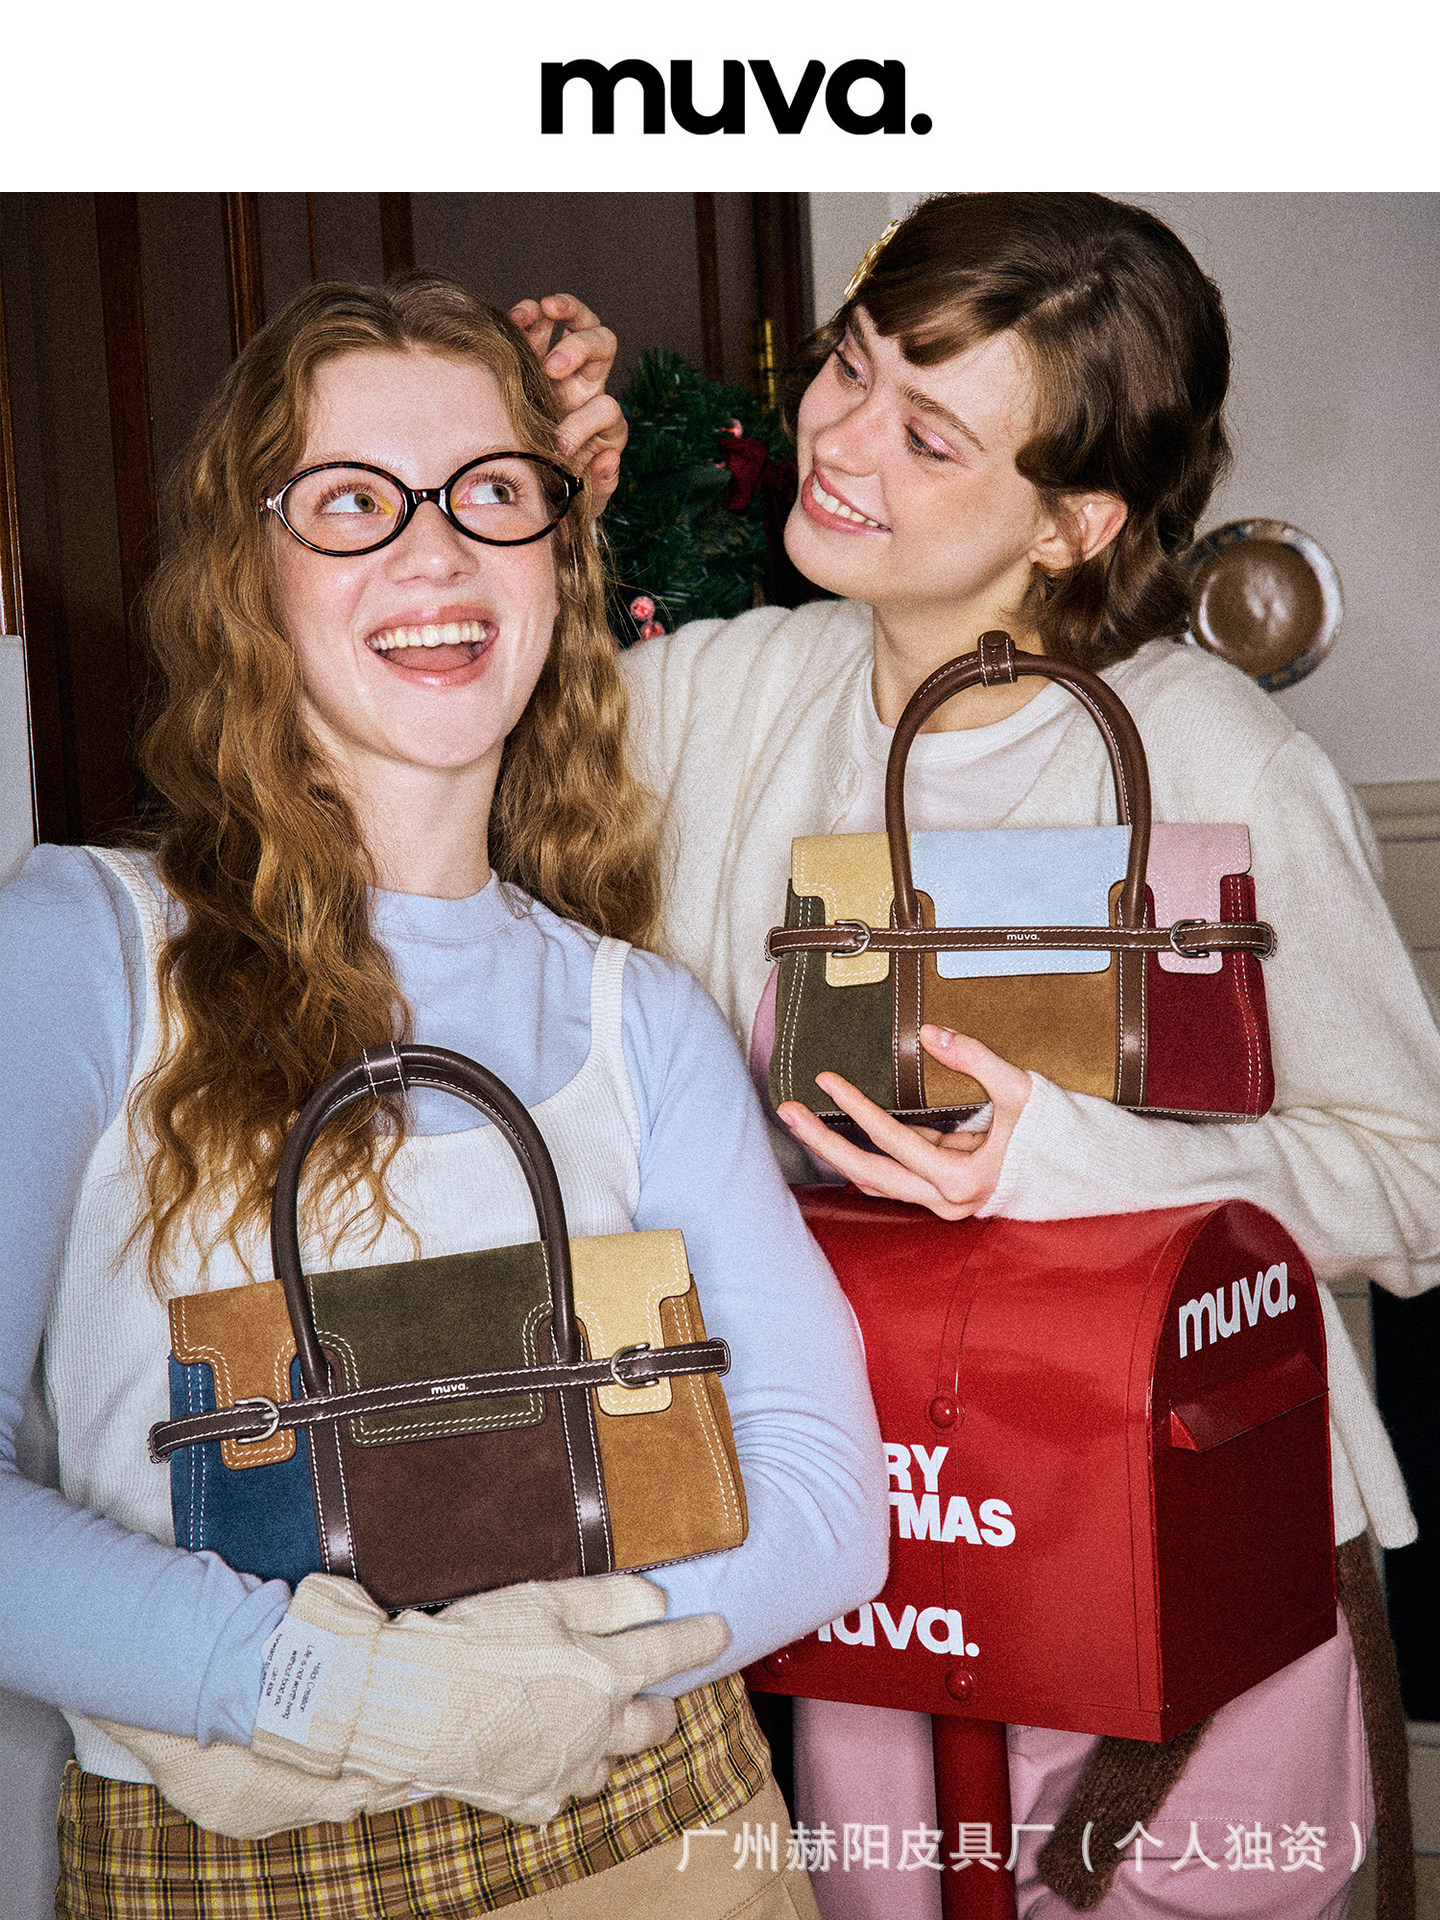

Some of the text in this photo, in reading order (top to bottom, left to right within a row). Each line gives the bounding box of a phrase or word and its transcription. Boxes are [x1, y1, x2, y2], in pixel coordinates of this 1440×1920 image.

[1006, 933, 1040, 941] muva.
[1178, 1261, 1296, 1359] muva.
[430, 1382, 469, 1395] muva.
[800, 1602, 980, 1658] uva.
